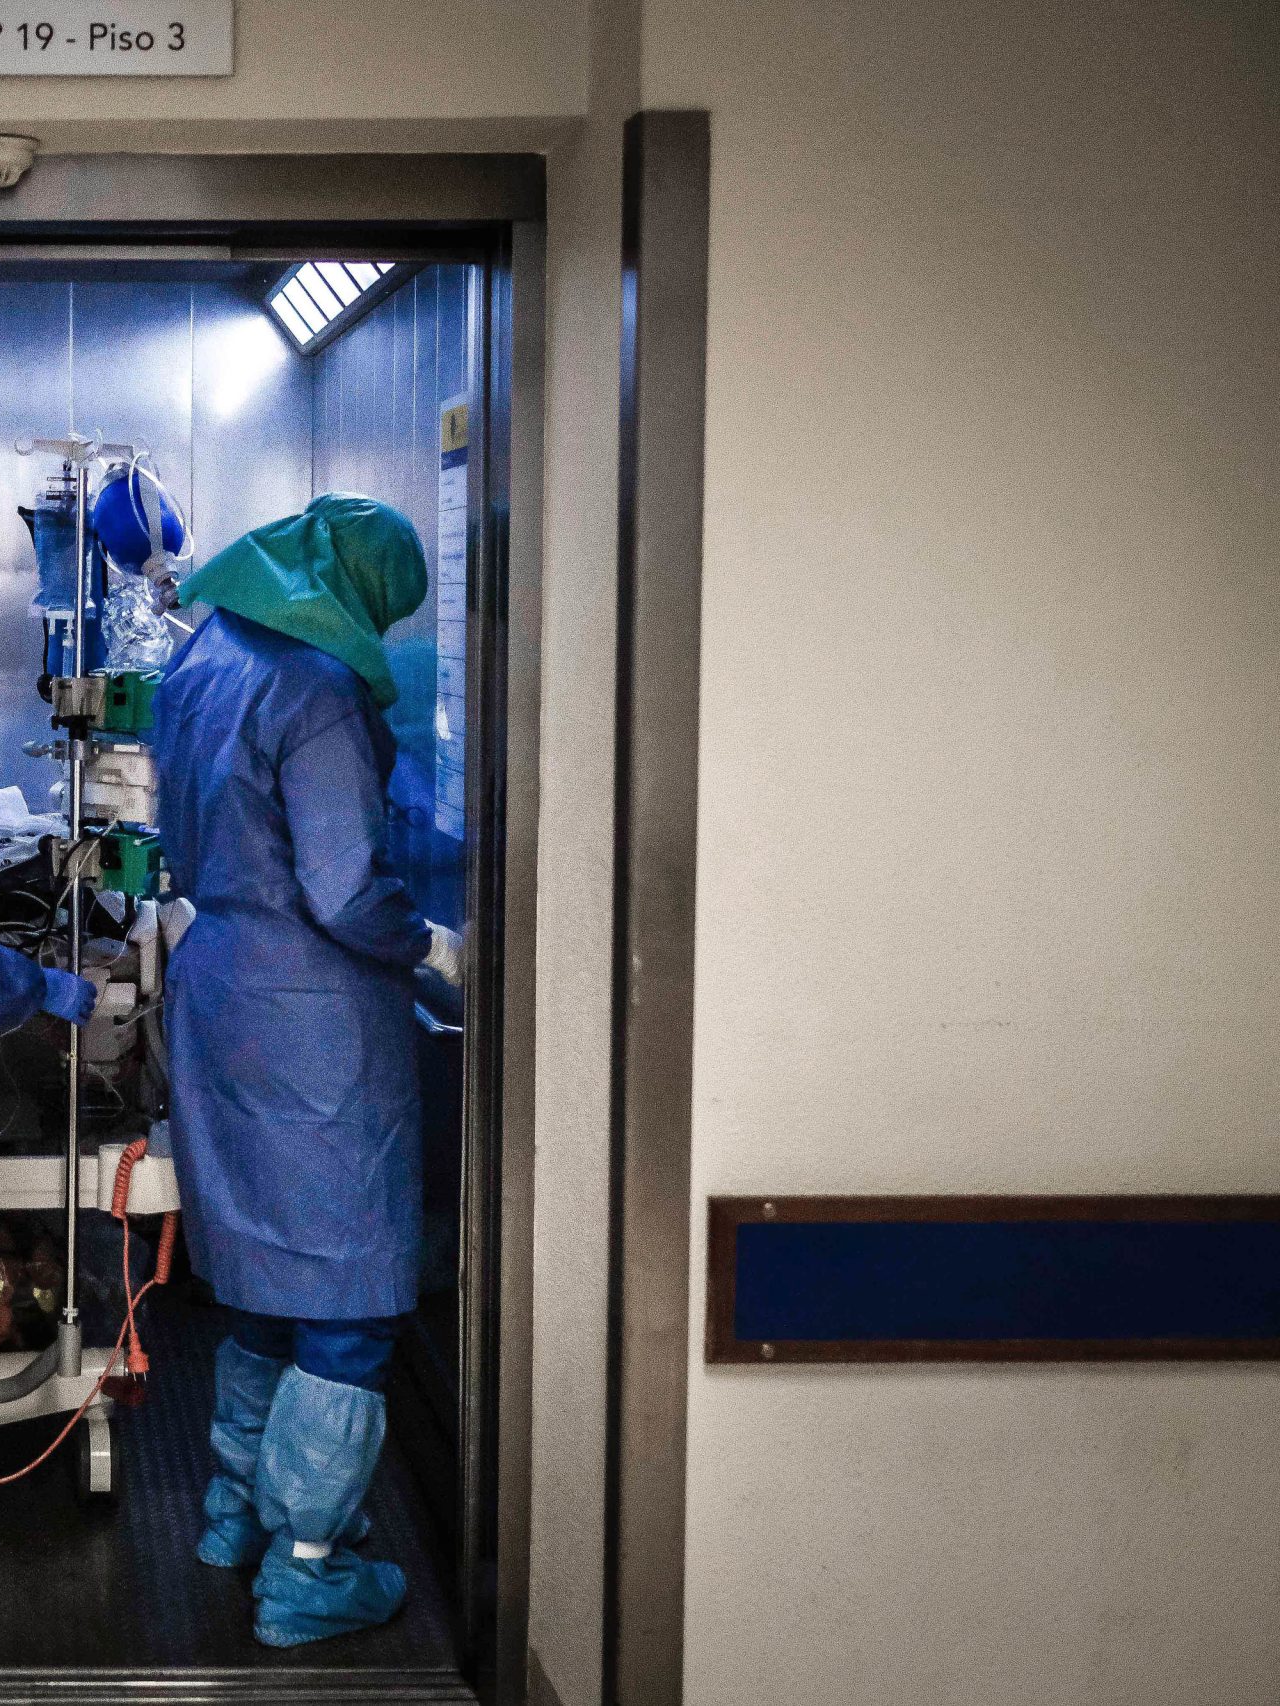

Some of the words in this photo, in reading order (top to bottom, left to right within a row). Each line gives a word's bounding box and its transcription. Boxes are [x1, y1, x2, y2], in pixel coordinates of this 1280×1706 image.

[16, 22, 54, 50] 19
[89, 22, 155, 51] Piso
[168, 22, 186, 51] 3
